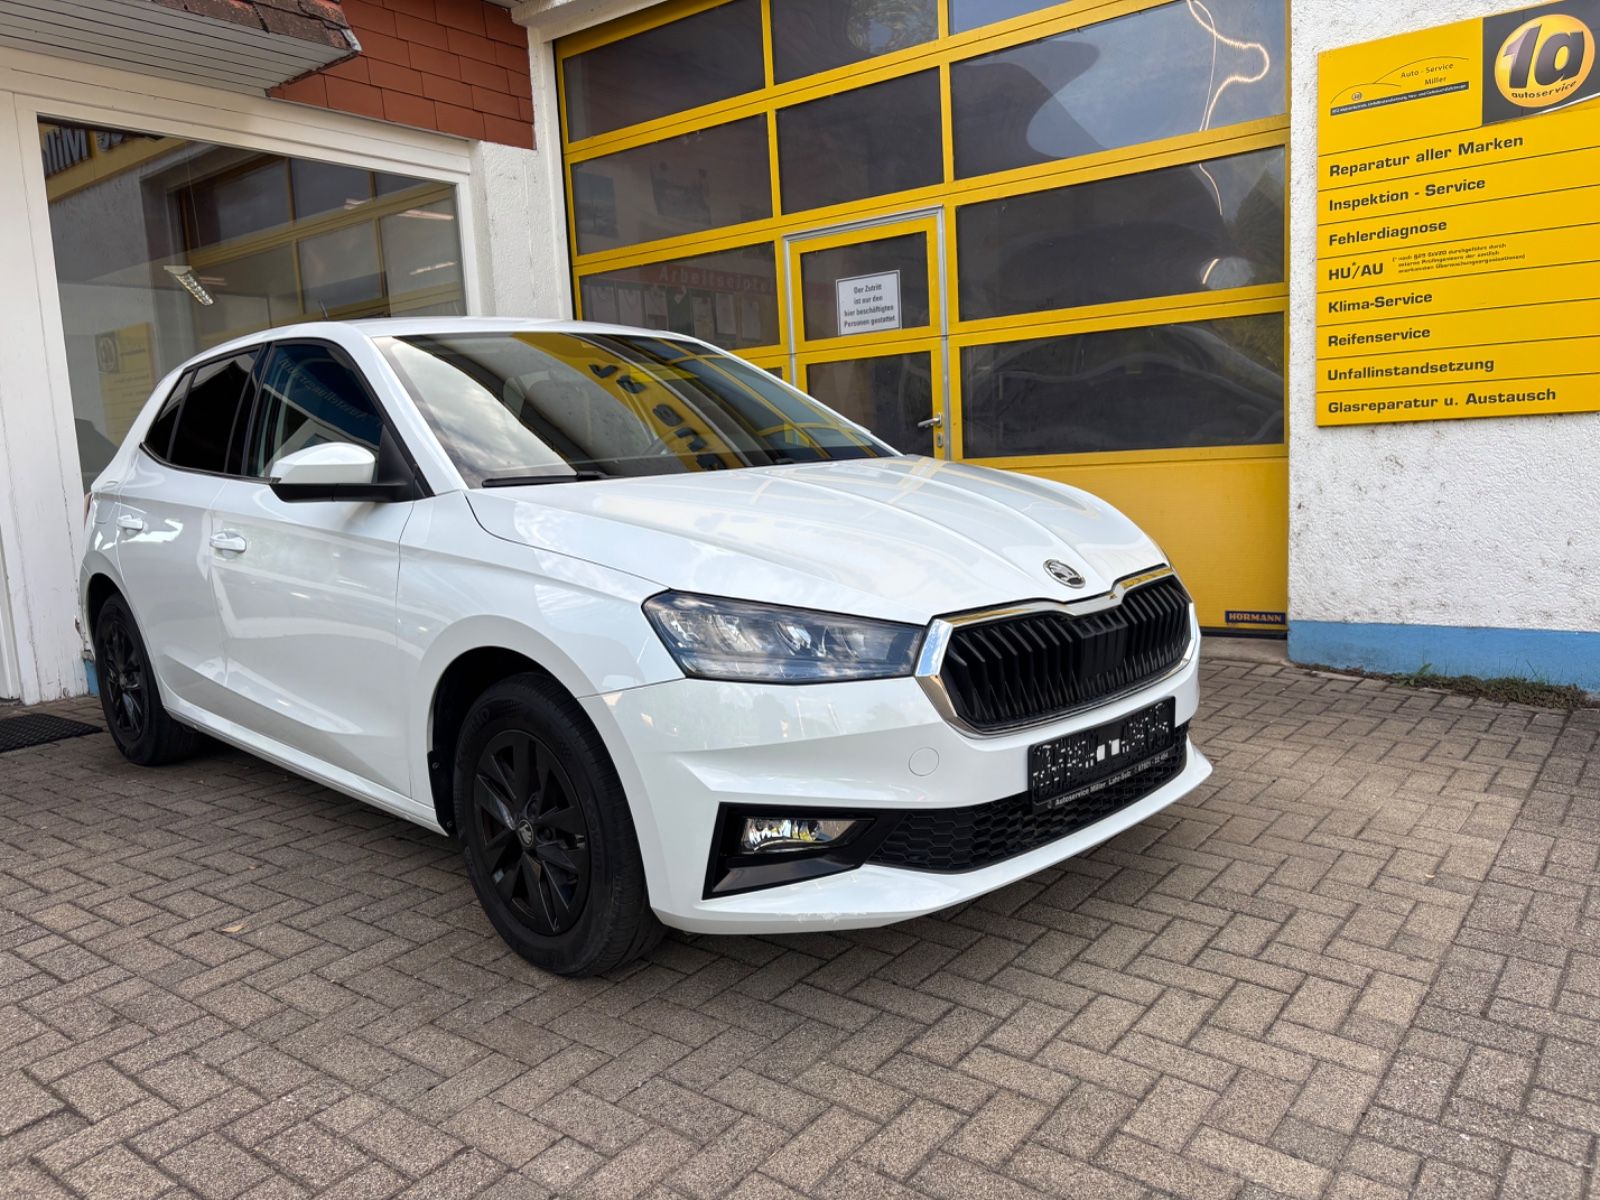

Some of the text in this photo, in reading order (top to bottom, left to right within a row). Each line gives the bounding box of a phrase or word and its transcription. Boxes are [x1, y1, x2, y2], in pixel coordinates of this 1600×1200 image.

[1503, 24, 1584, 88] 1a
[1401, 69, 1420, 79] Auto
[1426, 63, 1454, 74] Service
[1424, 76, 1447, 86] Miller
[1511, 81, 1577, 98] autoservice
[1329, 136, 1524, 177] Reparatur aller Marken
[1329, 190, 1409, 211] Inspektion
[1425, 178, 1486, 197] Service
[1329, 221, 1447, 246] Fehlerdiagnose
[853, 284, 882, 294] Der Zutritt
[1328, 292, 1433, 313] Klima-Service
[1328, 327, 1431, 347] Reifenservice
[1327, 359, 1494, 381] Unfallinstandsetzung
[1327, 388, 1557, 413] Glasreparatur u. Austausch
